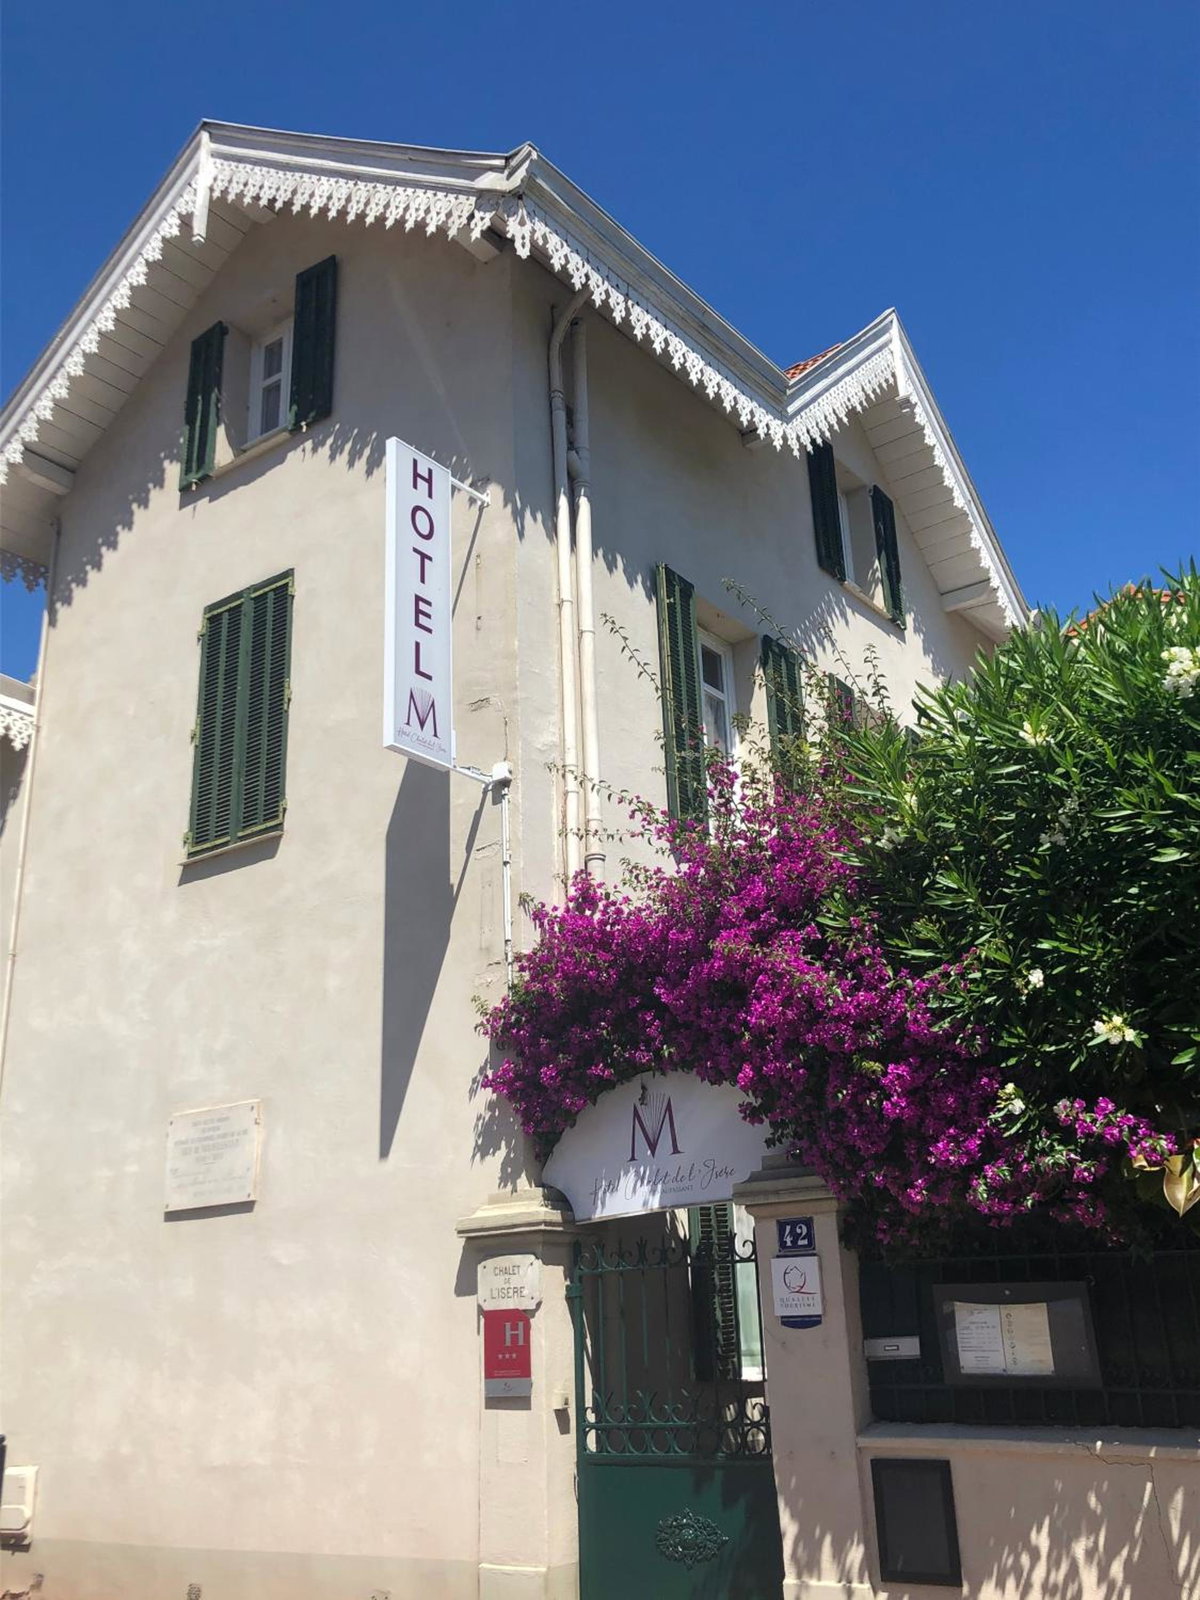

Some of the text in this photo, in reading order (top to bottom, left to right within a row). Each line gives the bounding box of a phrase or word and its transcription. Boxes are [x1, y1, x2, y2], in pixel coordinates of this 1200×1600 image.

[410, 457, 435, 681] HOTEL
[404, 687, 441, 739] M
[627, 1096, 685, 1162] M
[783, 1223, 808, 1247] 42
[493, 1264, 521, 1277] CHALET
[504, 1321, 525, 1347] H
